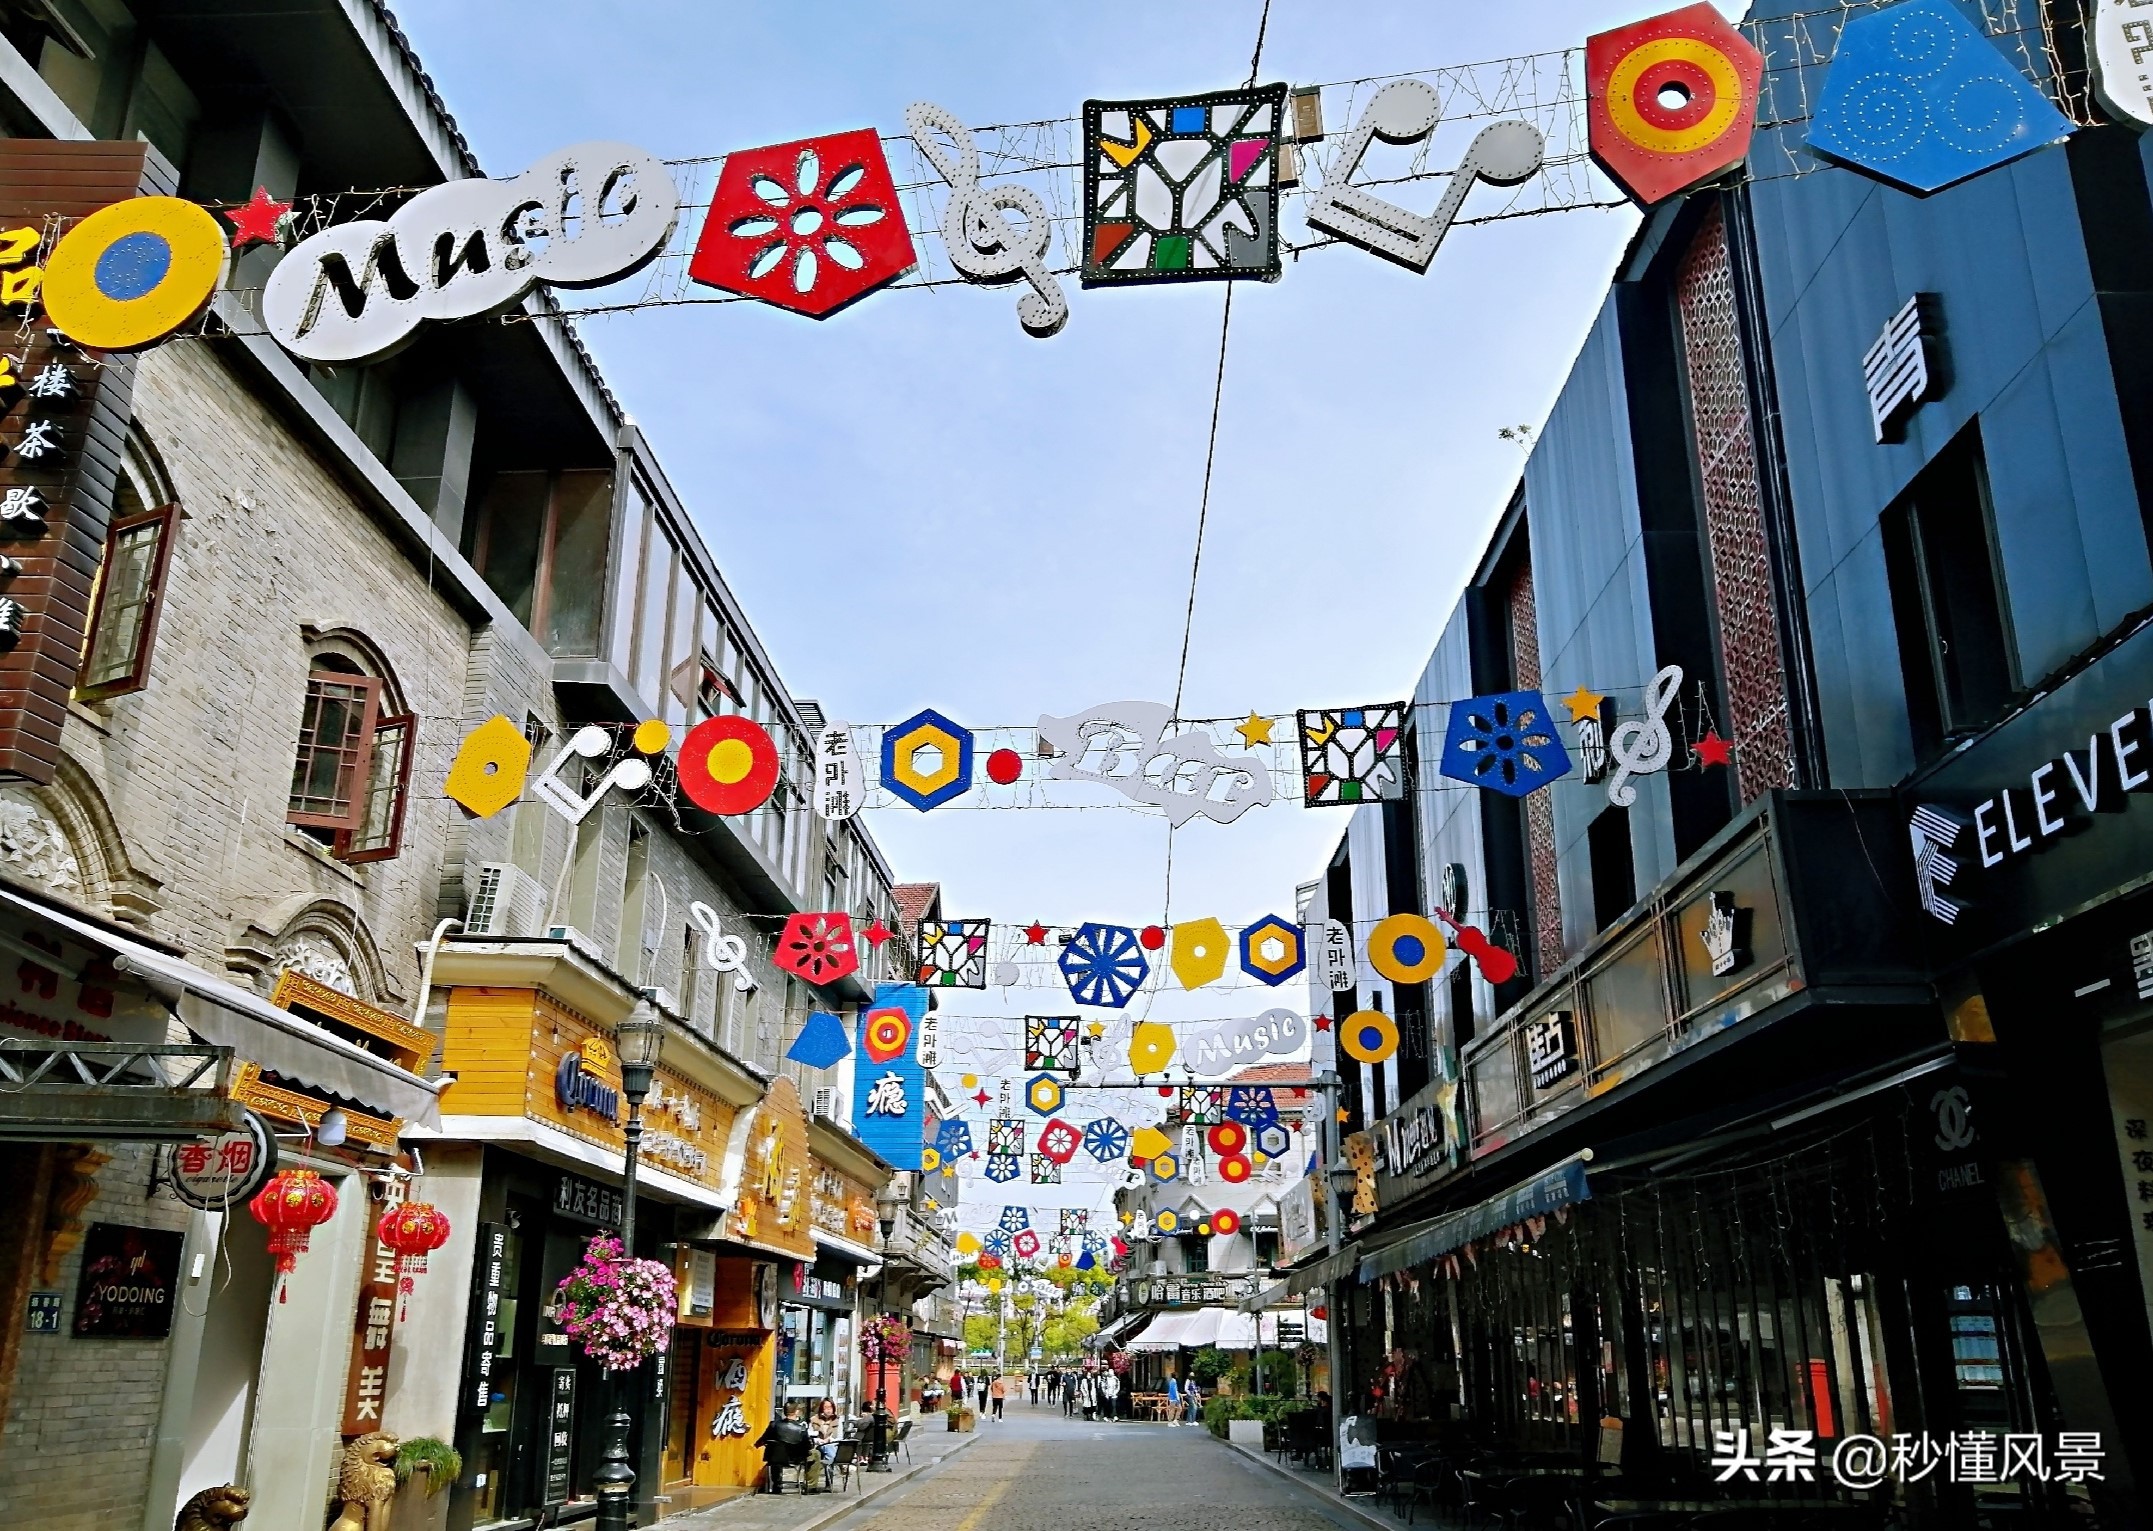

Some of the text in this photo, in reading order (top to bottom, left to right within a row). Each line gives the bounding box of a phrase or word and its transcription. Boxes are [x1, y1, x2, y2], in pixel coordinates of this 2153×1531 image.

[296, 161, 639, 340] Music
[1078, 718, 1256, 803] Beer
[1974, 697, 2153, 869] ELEVE
[1197, 1013, 1296, 1067] Music
[179, 1141, 253, 1173] 香烟
[1937, 1162, 1985, 1192] CHANEL
[100, 1285, 165, 1304] YODOING
[1151, 1284, 1227, 1301] 哈雷音乐酒吧
[477, 1233, 504, 1407] 贵重物品寄售
[713, 1357, 752, 1437] 酒瘾
[553, 1430, 568, 1447] 回收
